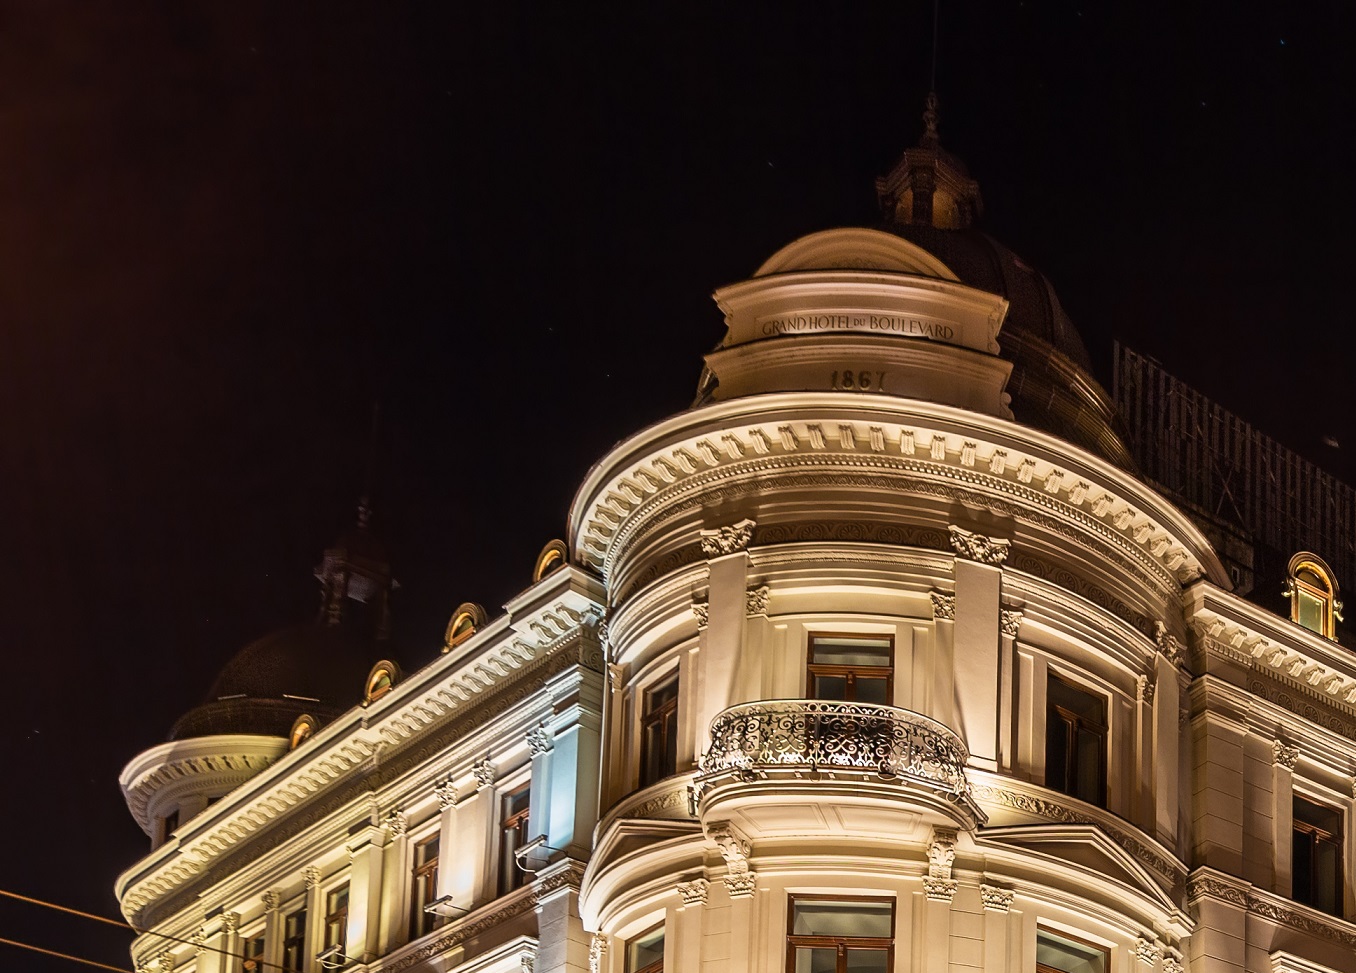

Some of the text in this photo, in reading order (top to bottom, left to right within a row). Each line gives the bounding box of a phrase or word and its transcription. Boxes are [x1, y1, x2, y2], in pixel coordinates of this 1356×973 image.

[762, 315, 954, 340] GRAND HOTEL DU BOULEVARD
[831, 370, 885, 391] 1867
